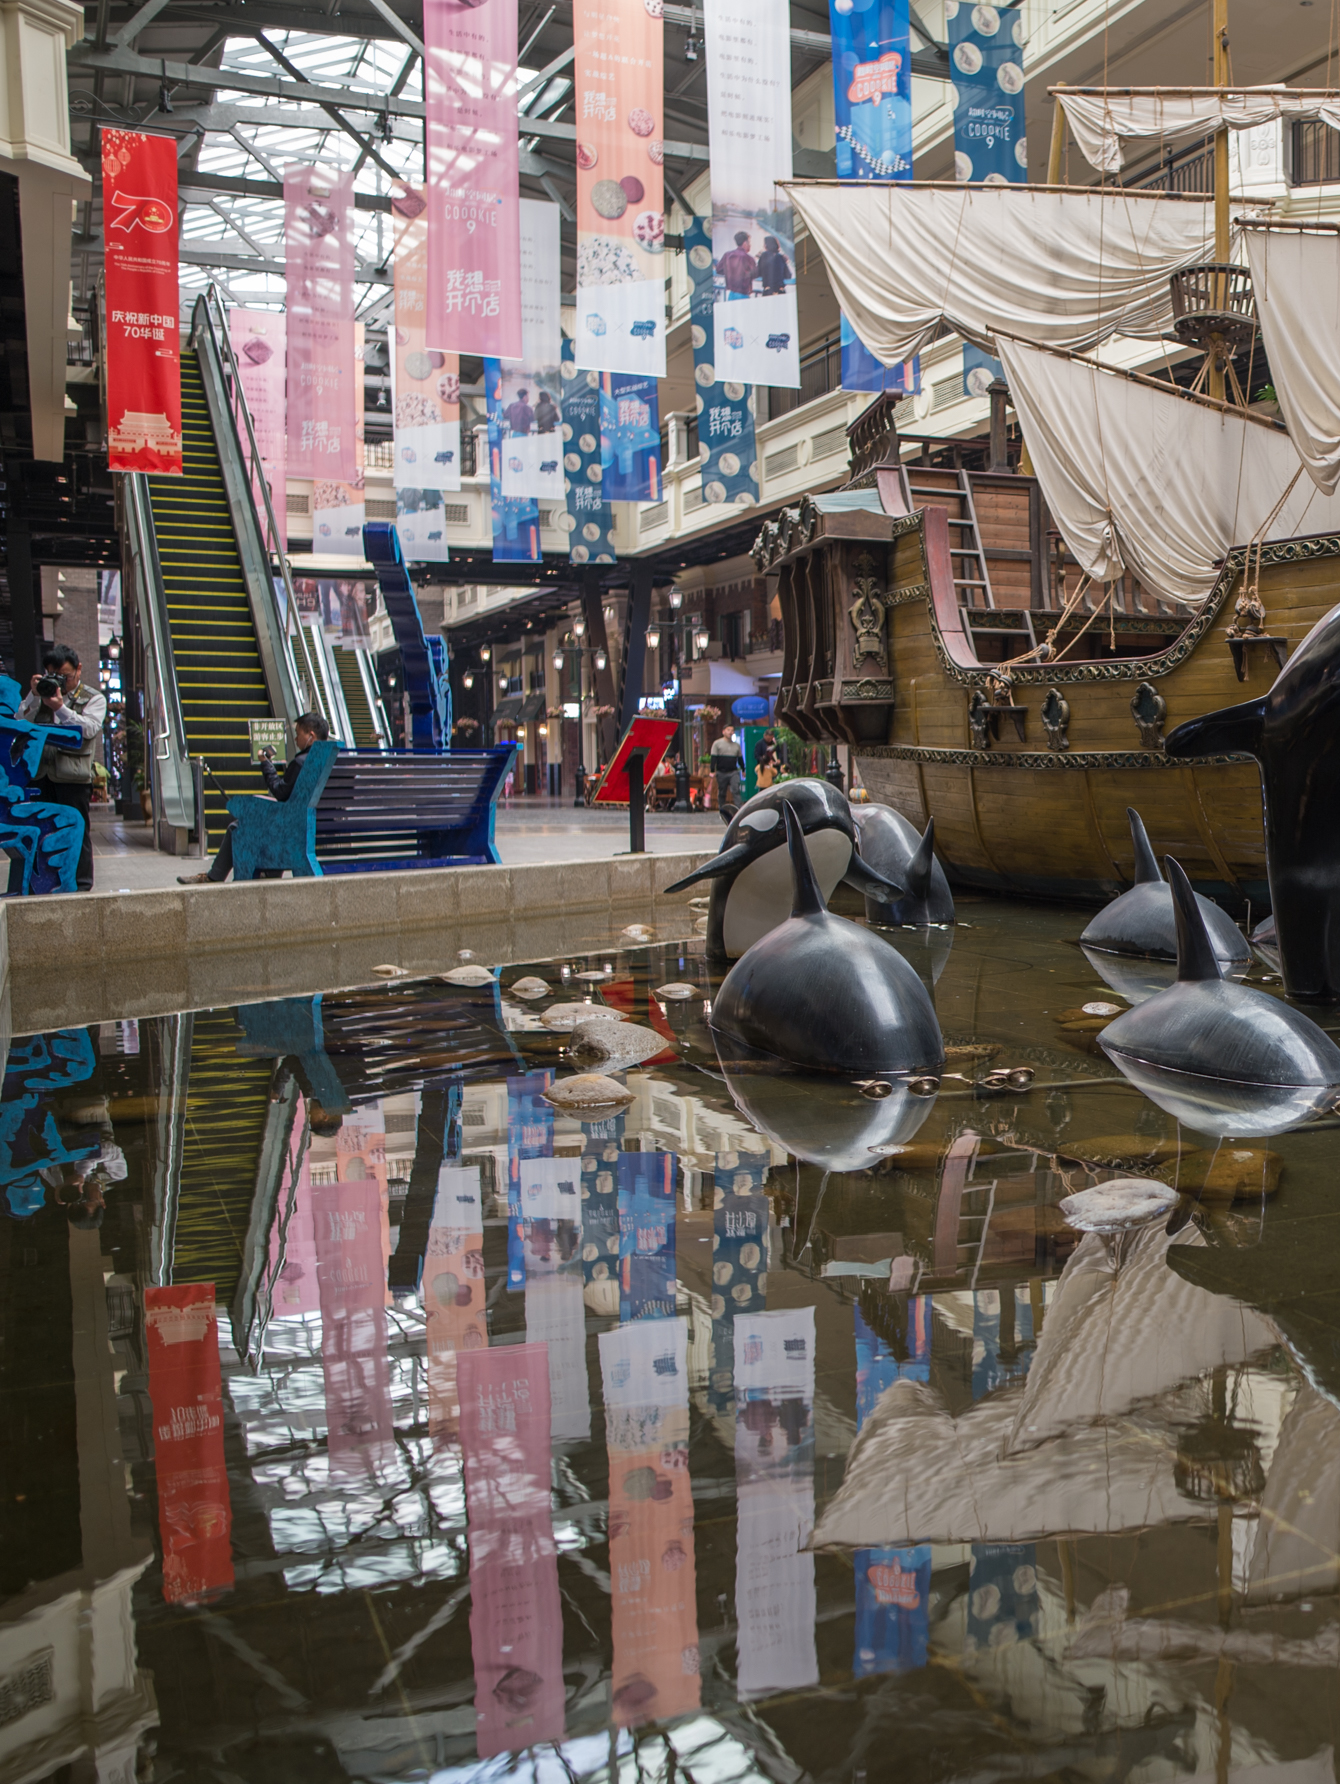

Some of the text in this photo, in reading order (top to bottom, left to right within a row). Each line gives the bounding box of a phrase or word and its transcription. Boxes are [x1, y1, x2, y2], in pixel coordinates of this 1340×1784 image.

[856, 76, 897, 98] COOOKIE
[968, 123, 1010, 141] COOOKIE
[985, 136, 995, 149] 9
[445, 204, 497, 227] COOOKIE
[466, 220, 476, 234] 9
[447, 269, 483, 292] 我想
[446, 291, 500, 317] 开个店
[112, 310, 175, 329] 庆祝新中国
[123, 326, 165, 341] 70华诞
[301, 374, 339, 390] COOOKIE
[316, 386, 323, 396] 9
[709, 406, 732, 421] 我想
[302, 419, 329, 436] 我想
[709, 420, 742, 437] 开个店
[301, 435, 340, 454] 开个店
[254, 722, 283, 731] 非开放区
[253, 732, 284, 741] 游客止步
